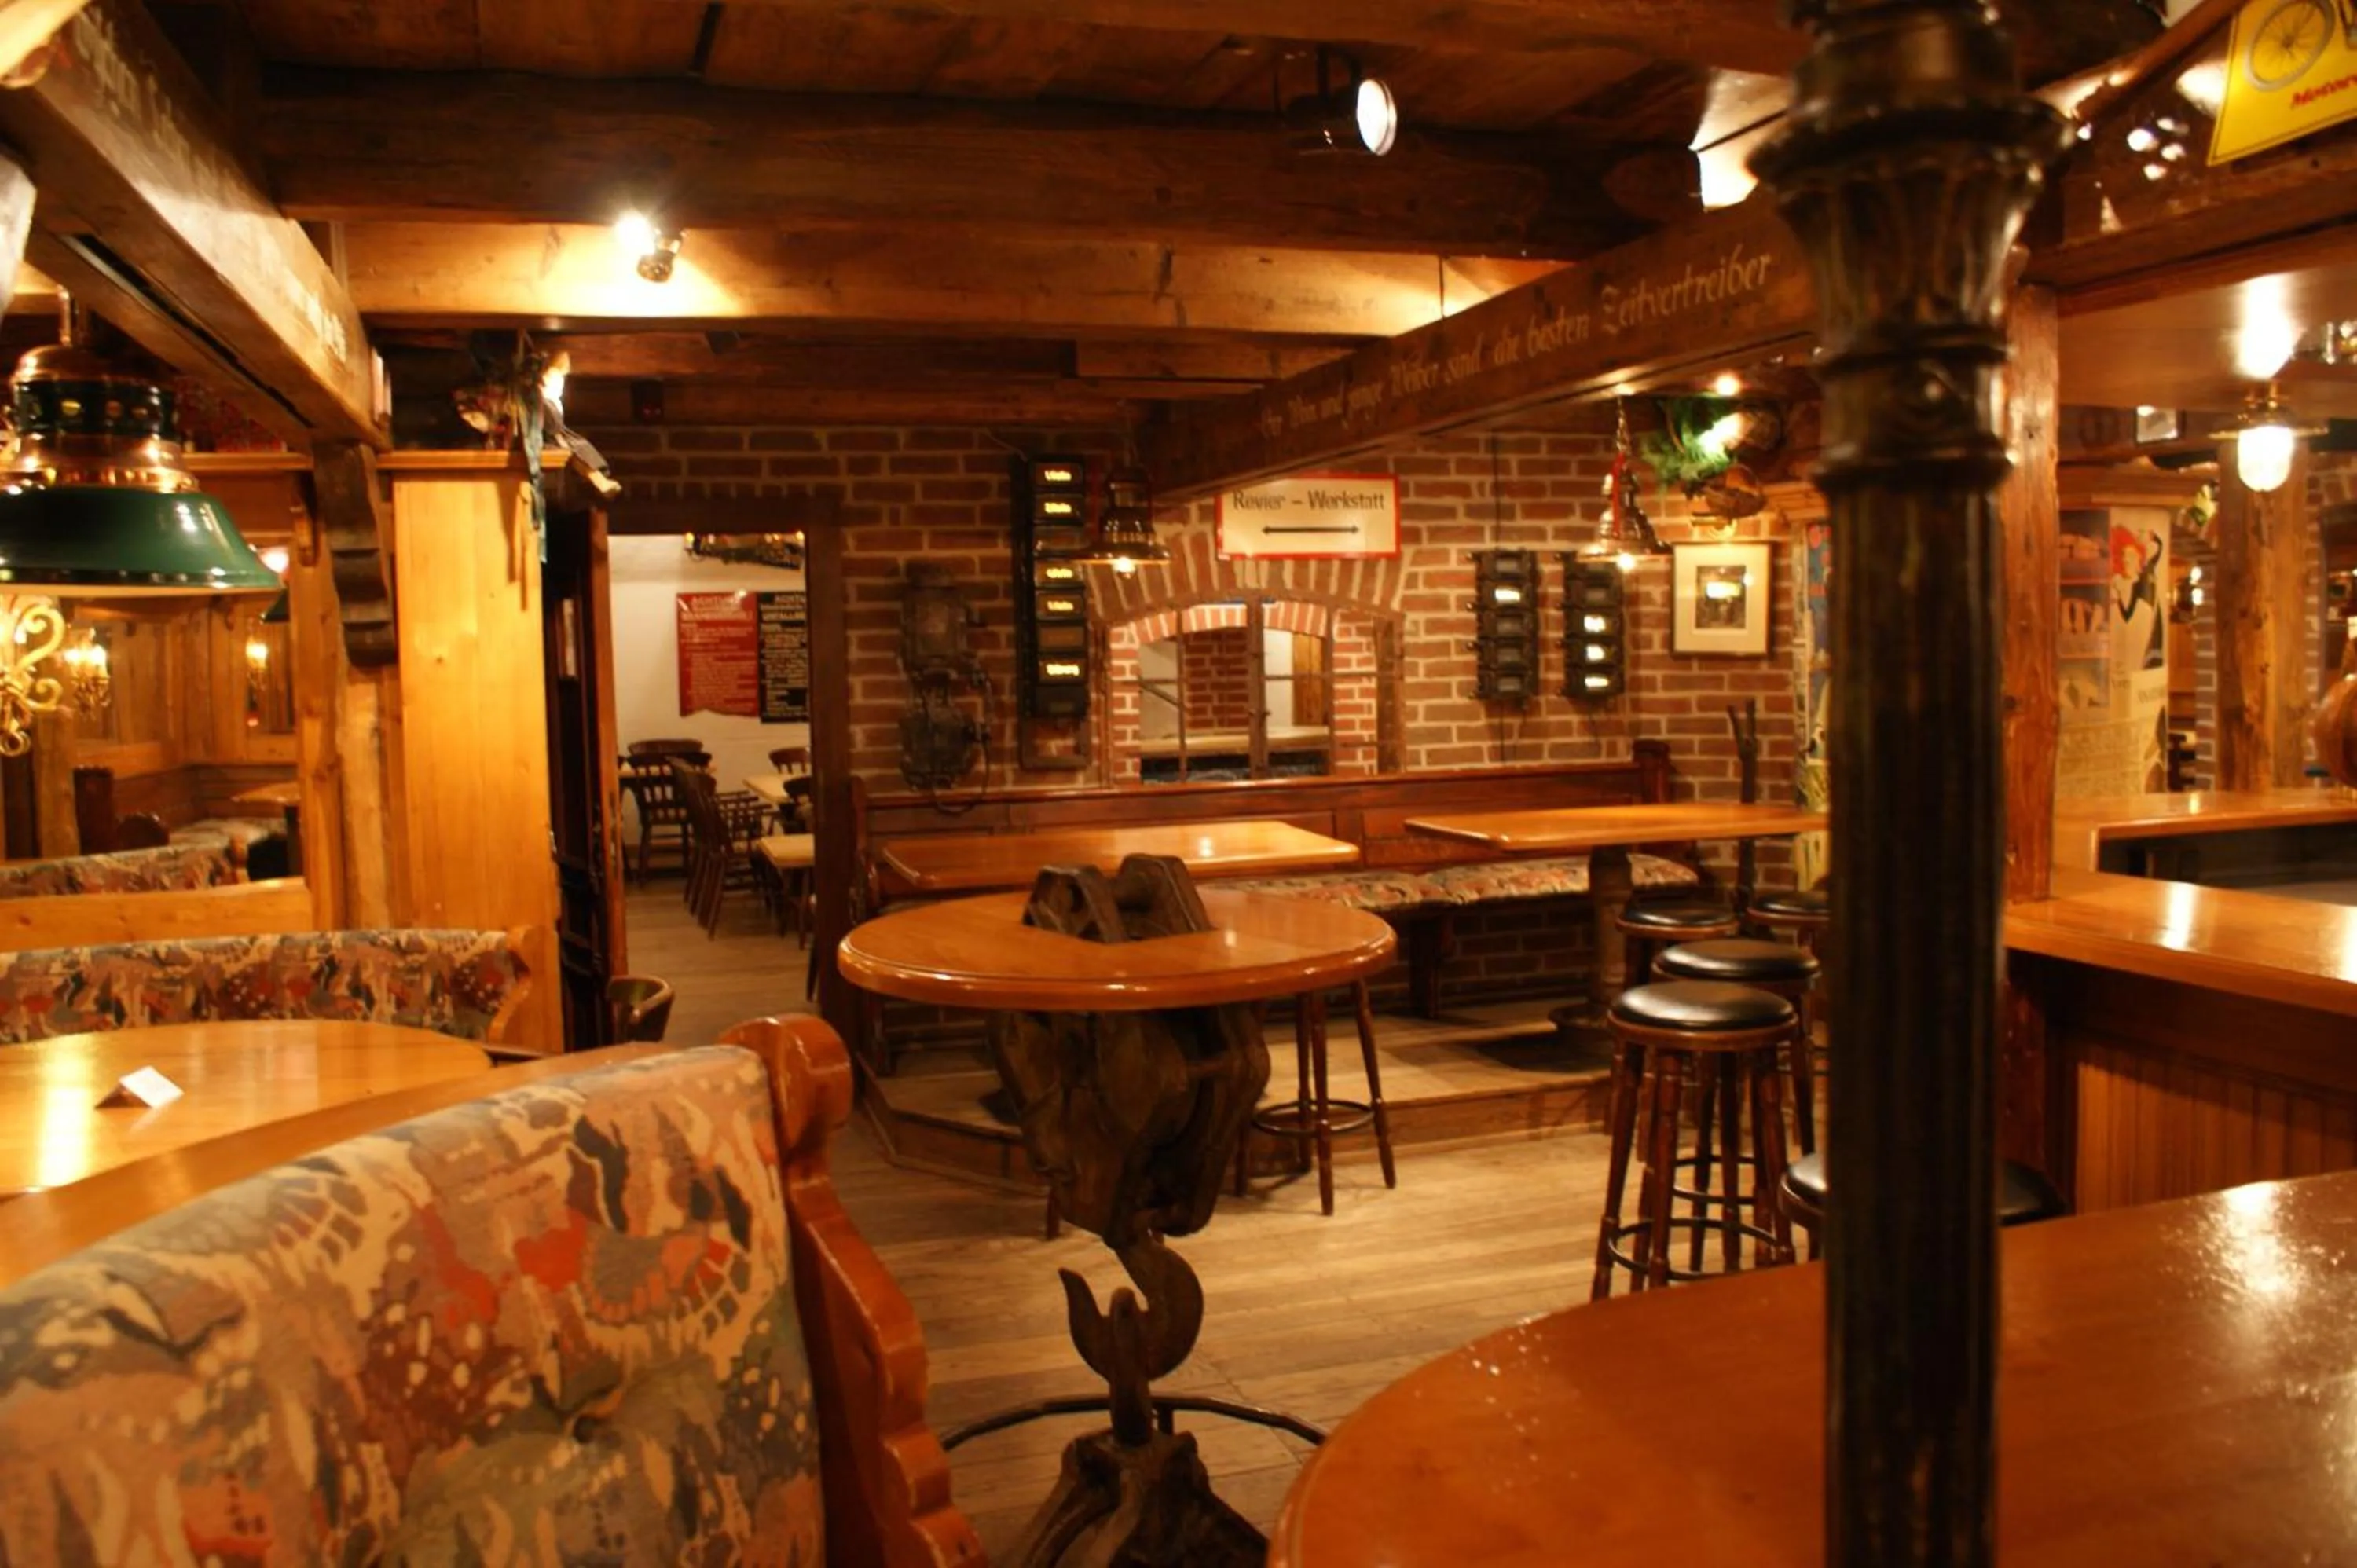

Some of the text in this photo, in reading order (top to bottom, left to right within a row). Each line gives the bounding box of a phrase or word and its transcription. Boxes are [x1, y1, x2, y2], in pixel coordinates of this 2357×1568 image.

[1443, 331, 1484, 384] sind
[1494, 324, 1520, 367] die
[1528, 305, 1591, 358] besten
[1601, 243, 1772, 335] Zeitvertreiber
[1233, 489, 1286, 511] Revier
[1307, 489, 1385, 511] Werkstatt
